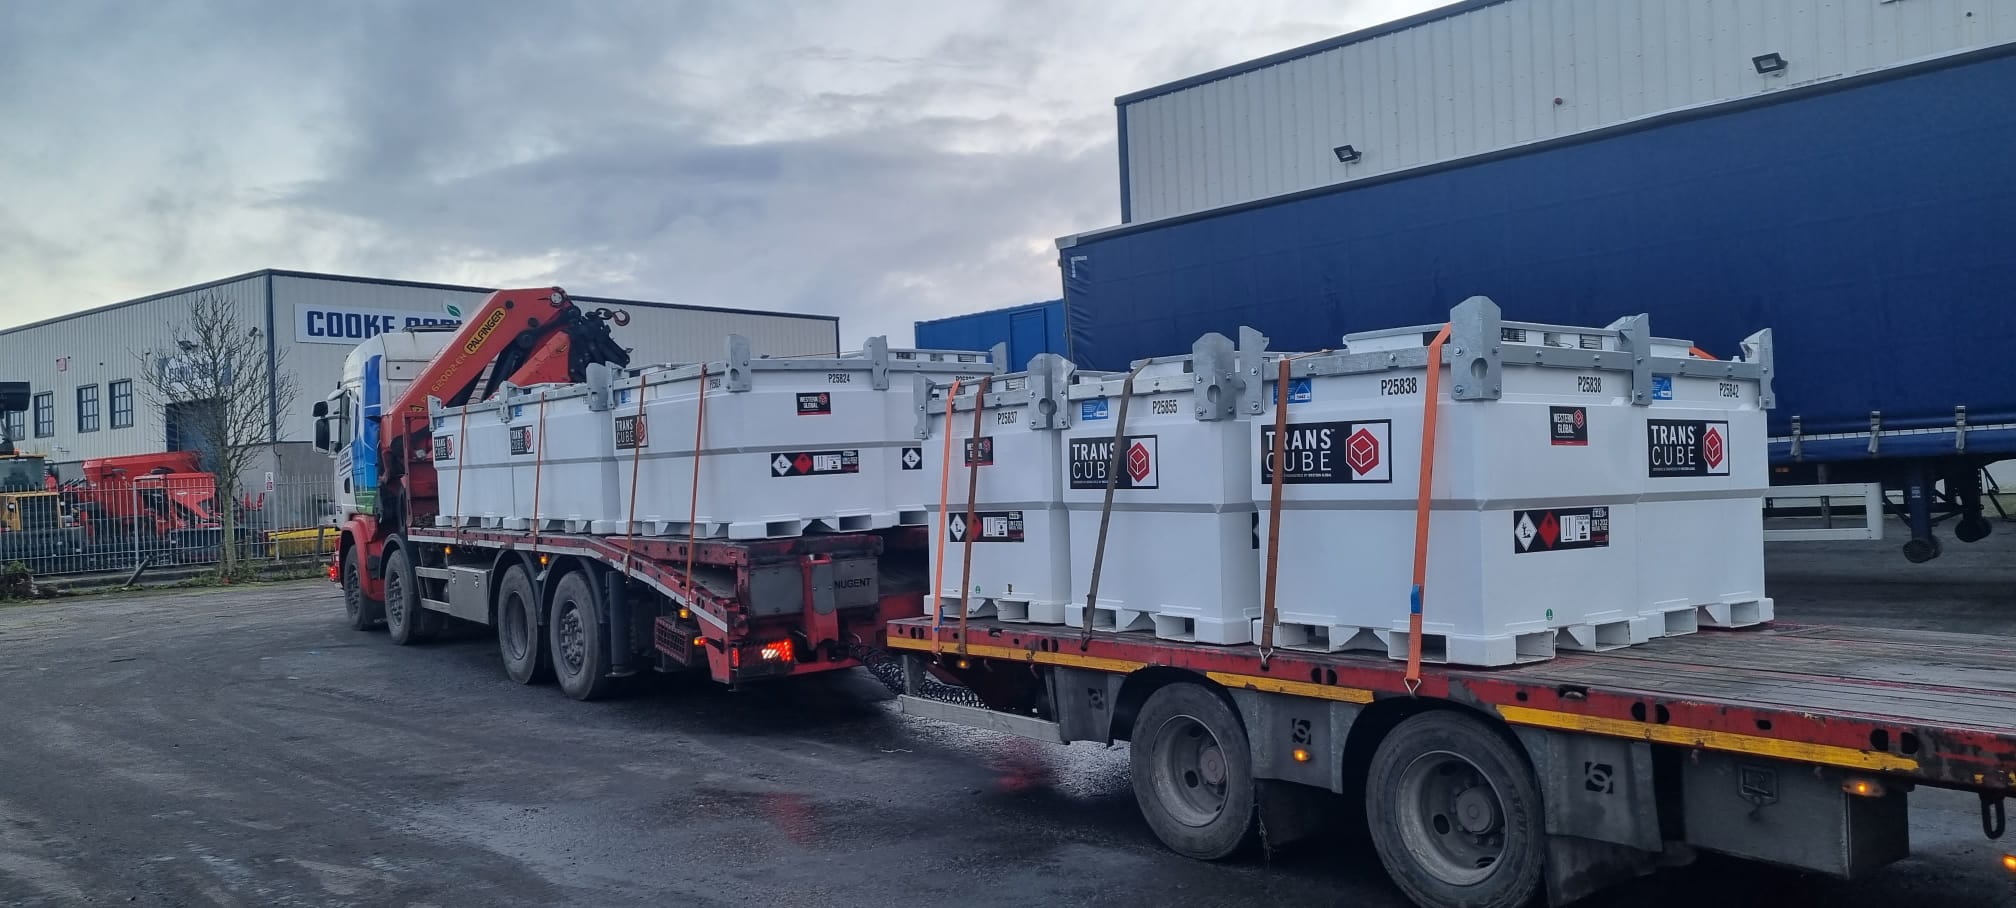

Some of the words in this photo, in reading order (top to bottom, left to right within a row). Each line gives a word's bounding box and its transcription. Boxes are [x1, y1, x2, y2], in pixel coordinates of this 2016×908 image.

[307, 311, 396, 339] COOKE
[466, 310, 504, 352] PALFINGER
[828, 373, 851, 384] P25824
[1381, 377, 1418, 396] P25838
[1578, 376, 1602, 393] P25838
[1719, 382, 1739, 398] P25842
[1152, 399, 1178, 415] P25855
[616, 419, 633, 431] TRANS
[997, 411, 1018, 425] P25837
[1553, 413, 1574, 423] WESTERN
[1557, 423, 1575, 434] GLOBAL
[1650, 425, 1695, 445] TRANS
[617, 431, 634, 443] CUBE
[1651, 446, 1696, 465] CUBE
[1072, 461, 1113, 479] CUB
[833, 577, 873, 589] NUGENT
